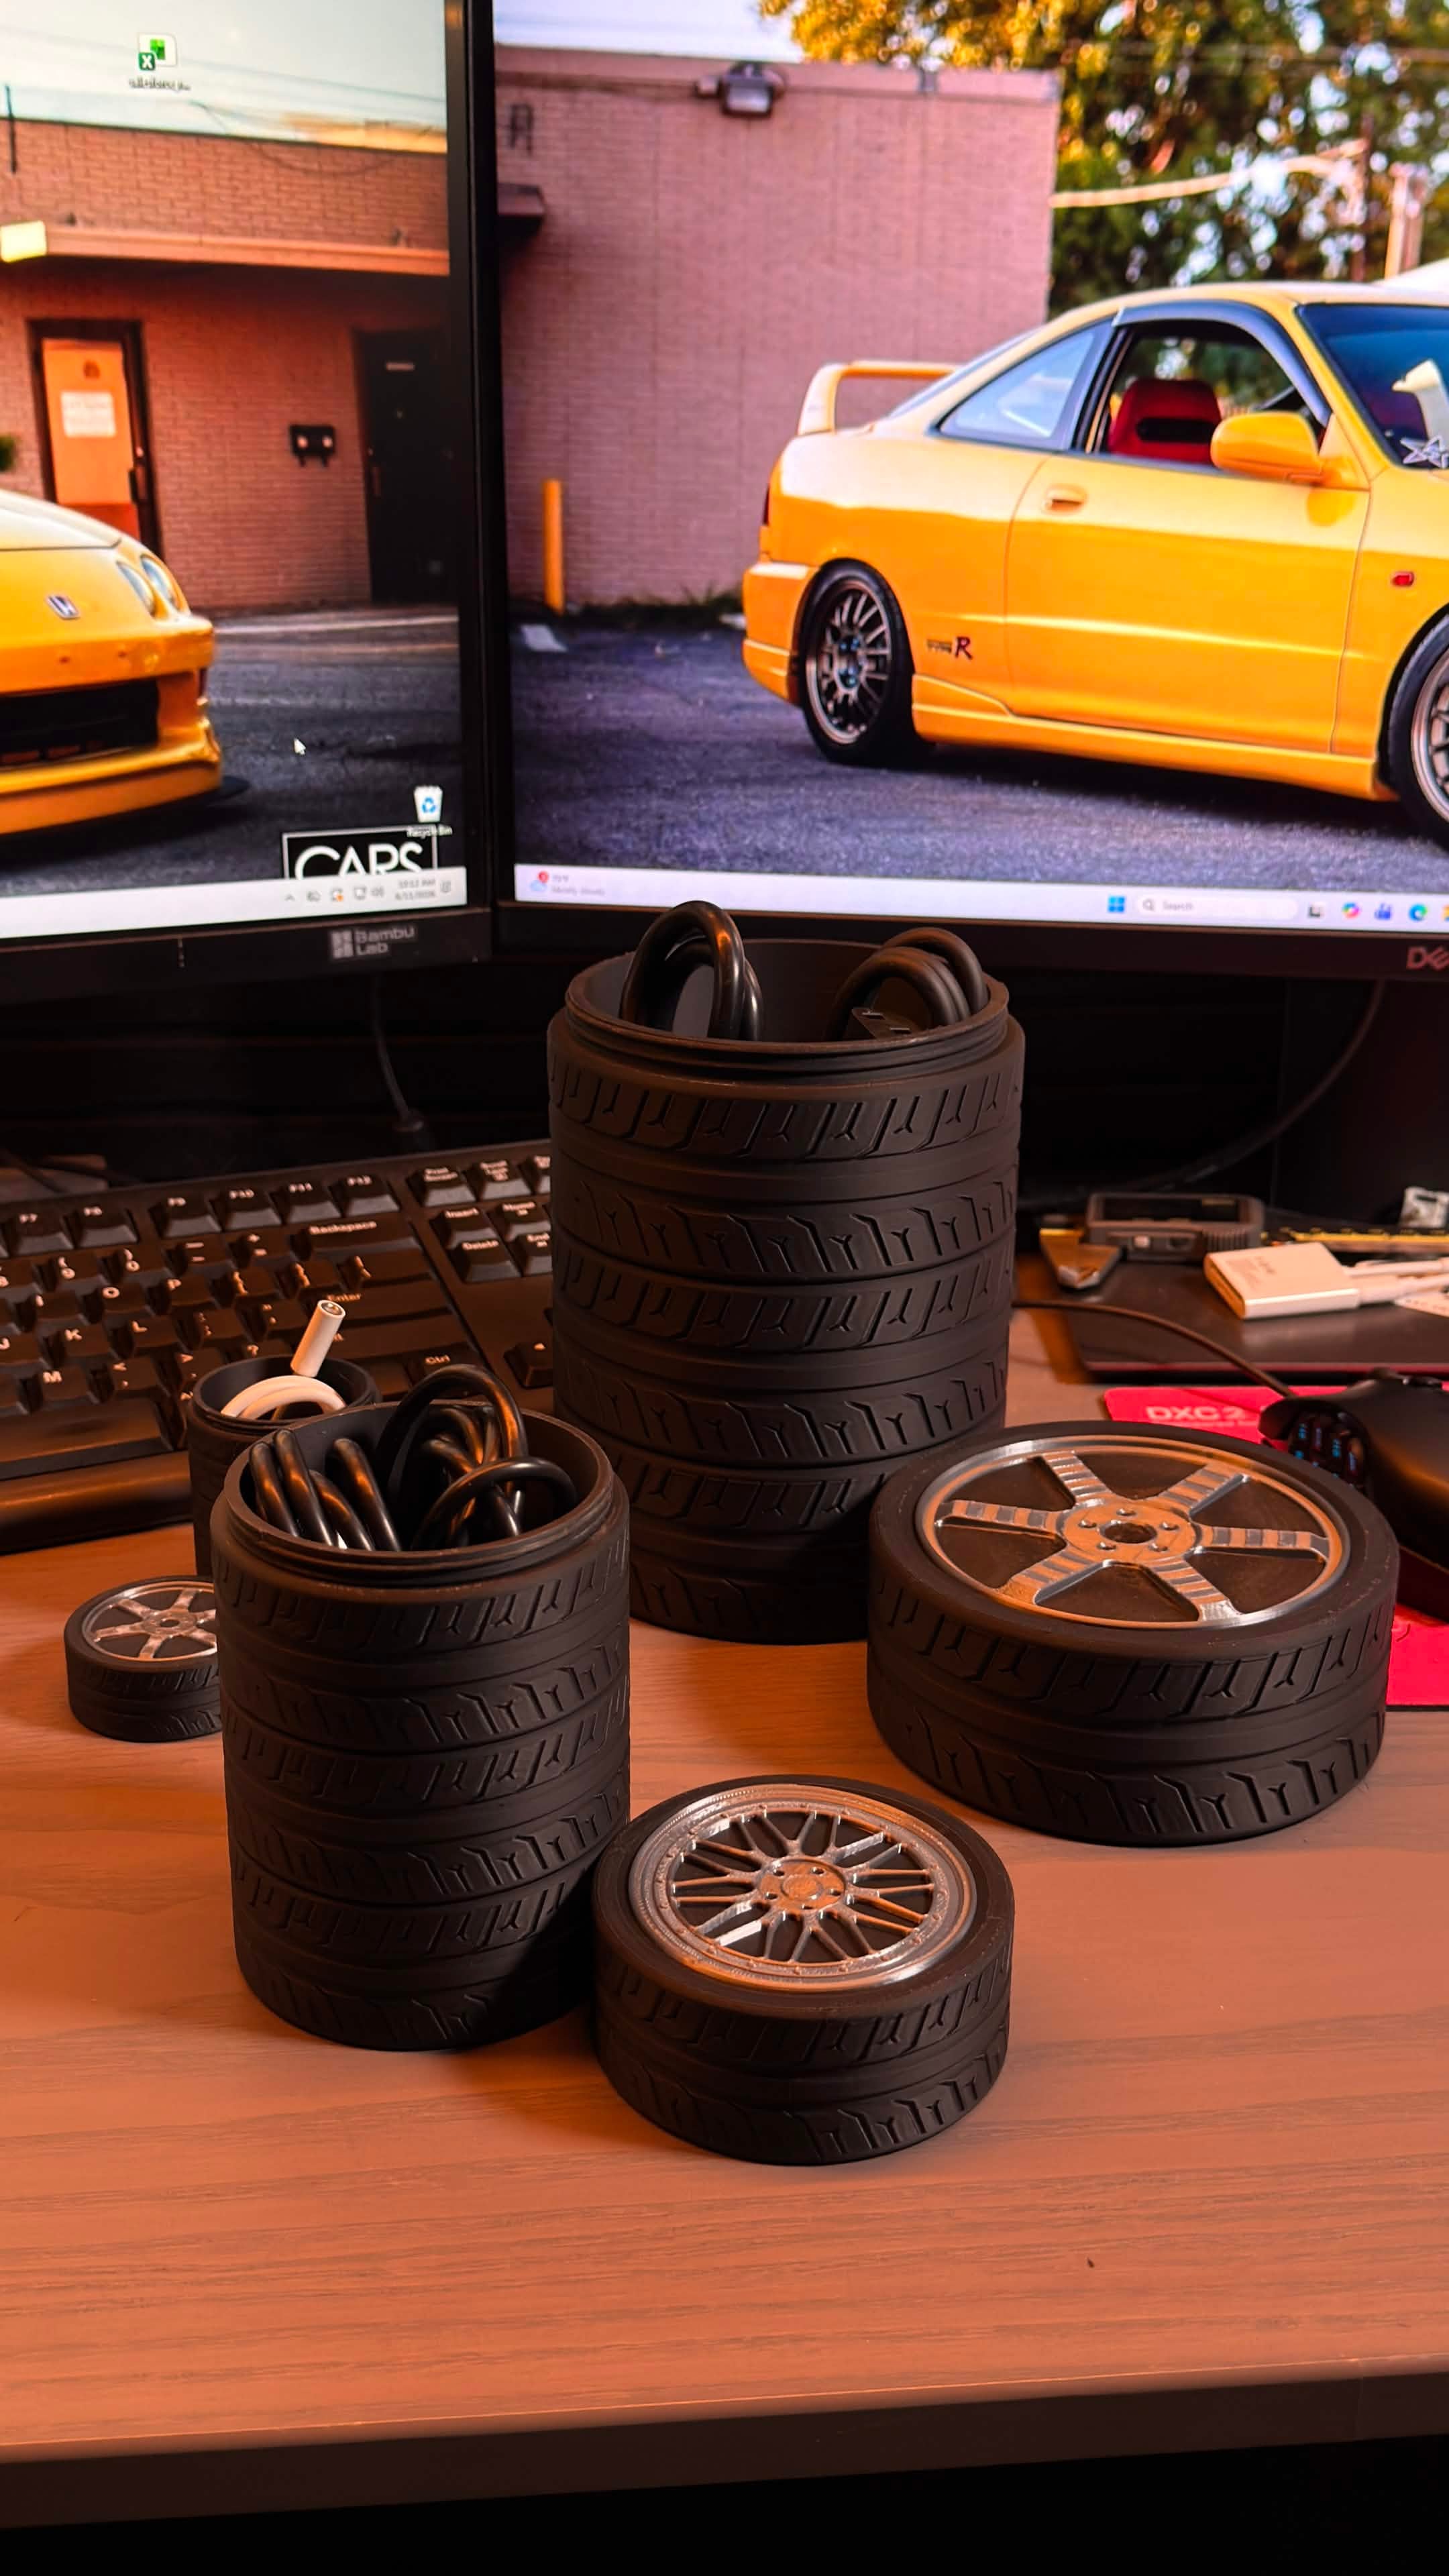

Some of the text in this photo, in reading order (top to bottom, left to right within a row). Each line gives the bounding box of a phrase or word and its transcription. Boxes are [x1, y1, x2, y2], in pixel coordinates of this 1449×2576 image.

[294, 841, 423, 880] CARS
[355, 927, 415, 944] Bambu
[356, 942, 388, 955] Lab
[1407, 945, 1449, 971] DE
[309, 1221, 377, 1235] Backspace
[462, 1240, 499, 1250] Delete
[327, 1293, 362, 1303] Enter
[64, 1329, 83, 1341] K
[425, 1354, 451, 1365] Ctrl
[43, 1371, 62, 1383] M
[1146, 1406, 1220, 1420] DXC
